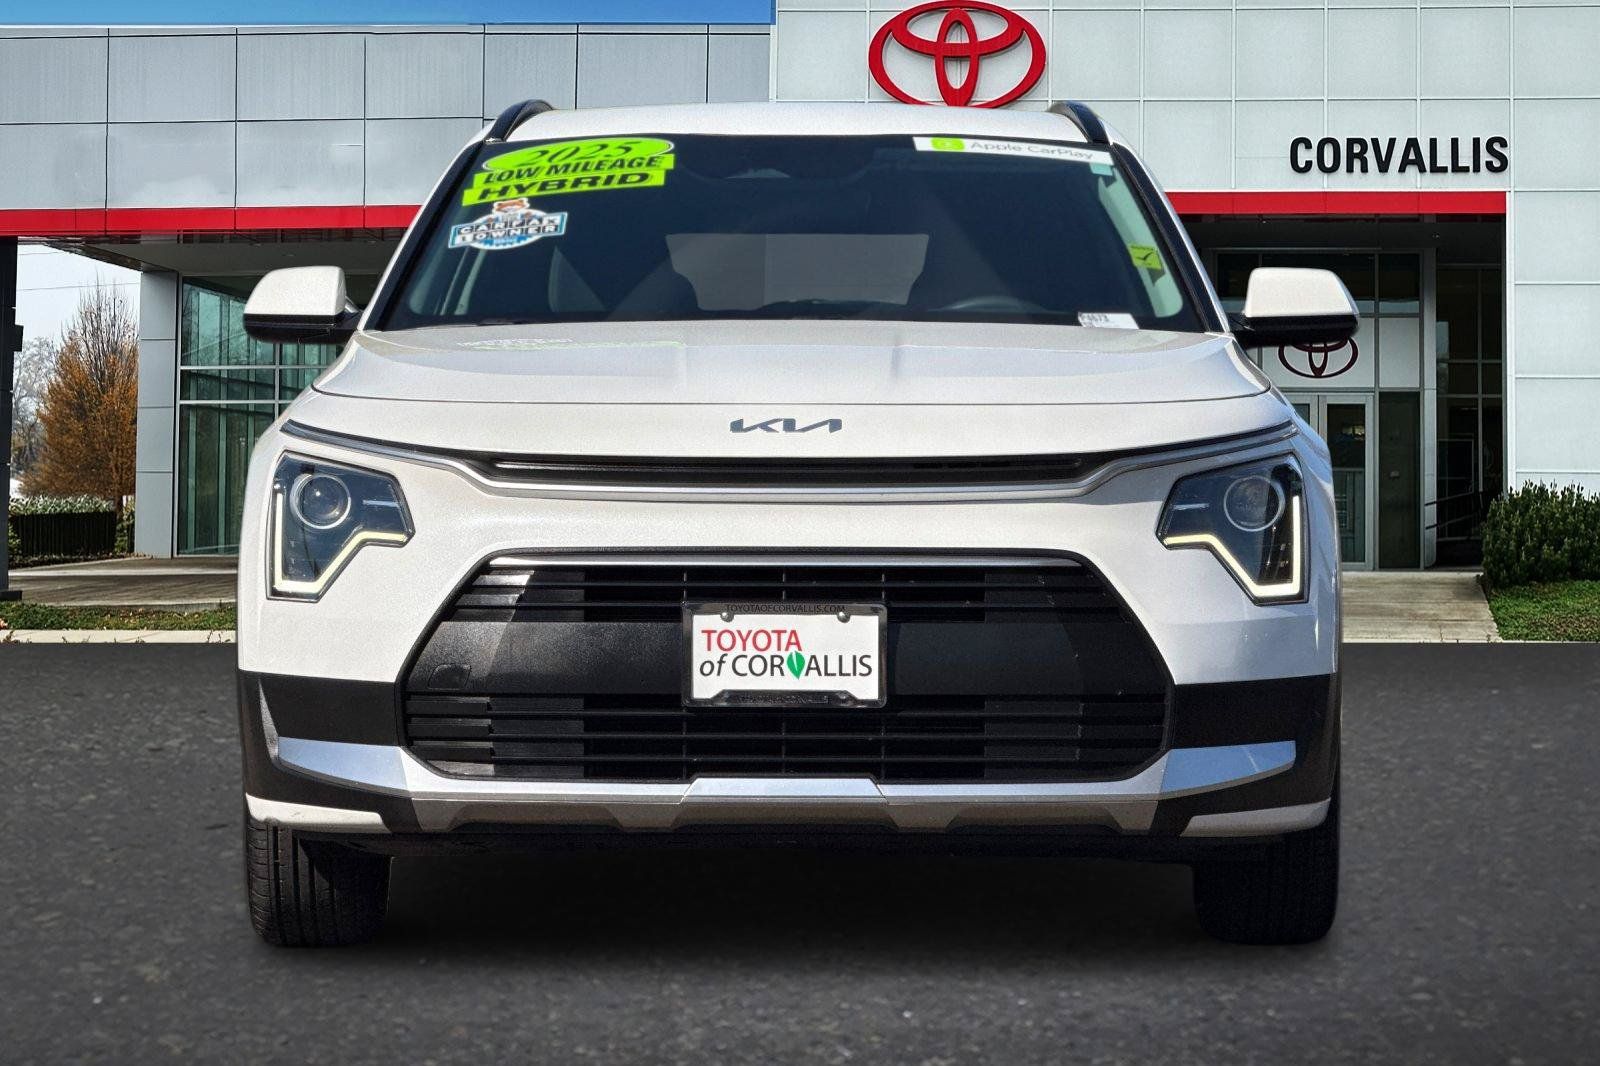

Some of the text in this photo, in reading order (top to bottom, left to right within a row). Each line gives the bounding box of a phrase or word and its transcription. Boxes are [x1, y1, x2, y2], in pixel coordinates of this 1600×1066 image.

[514, 140, 642, 168] 2025
[970, 141, 1022, 153] Apple
[1290, 136, 1509, 174] CORVALLIS
[484, 155, 664, 185] LOW MILEAGE
[477, 172, 650, 200] HYBRID
[730, 418, 842, 434] KIA
[701, 629, 803, 652] TOYOTA
[699, 652, 873, 679] of CORVALLIS
